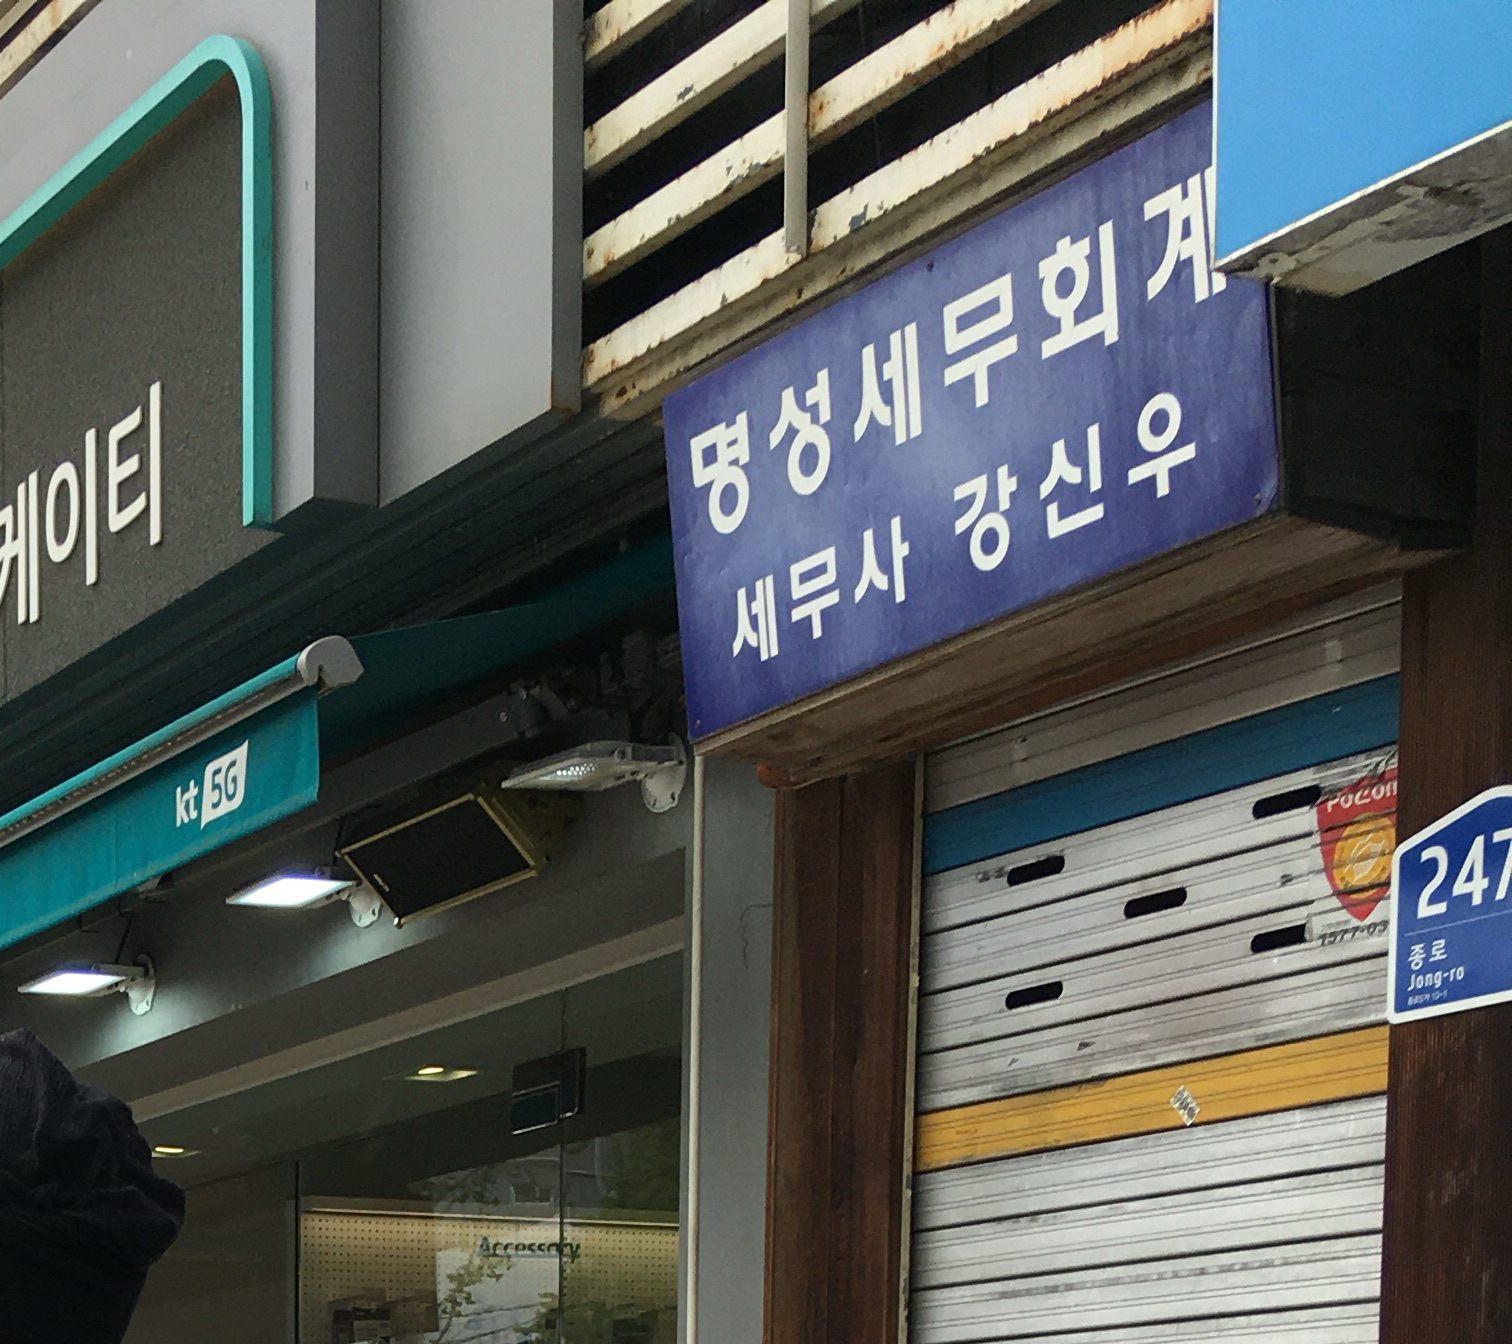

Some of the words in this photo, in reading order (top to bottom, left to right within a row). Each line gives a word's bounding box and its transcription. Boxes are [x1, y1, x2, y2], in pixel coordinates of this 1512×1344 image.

[689, 163, 1226, 536] 명성세무회계
[732, 515, 911, 663] 세무사
[954, 391, 1199, 572] 강신우
[176, 775, 199, 827] kt
[210, 757, 240, 811] 5G
[1417, 827, 1512, 919] 247
[1407, 965, 1465, 991] Jong-ro
[1408, 939, 1448, 971] 종로
